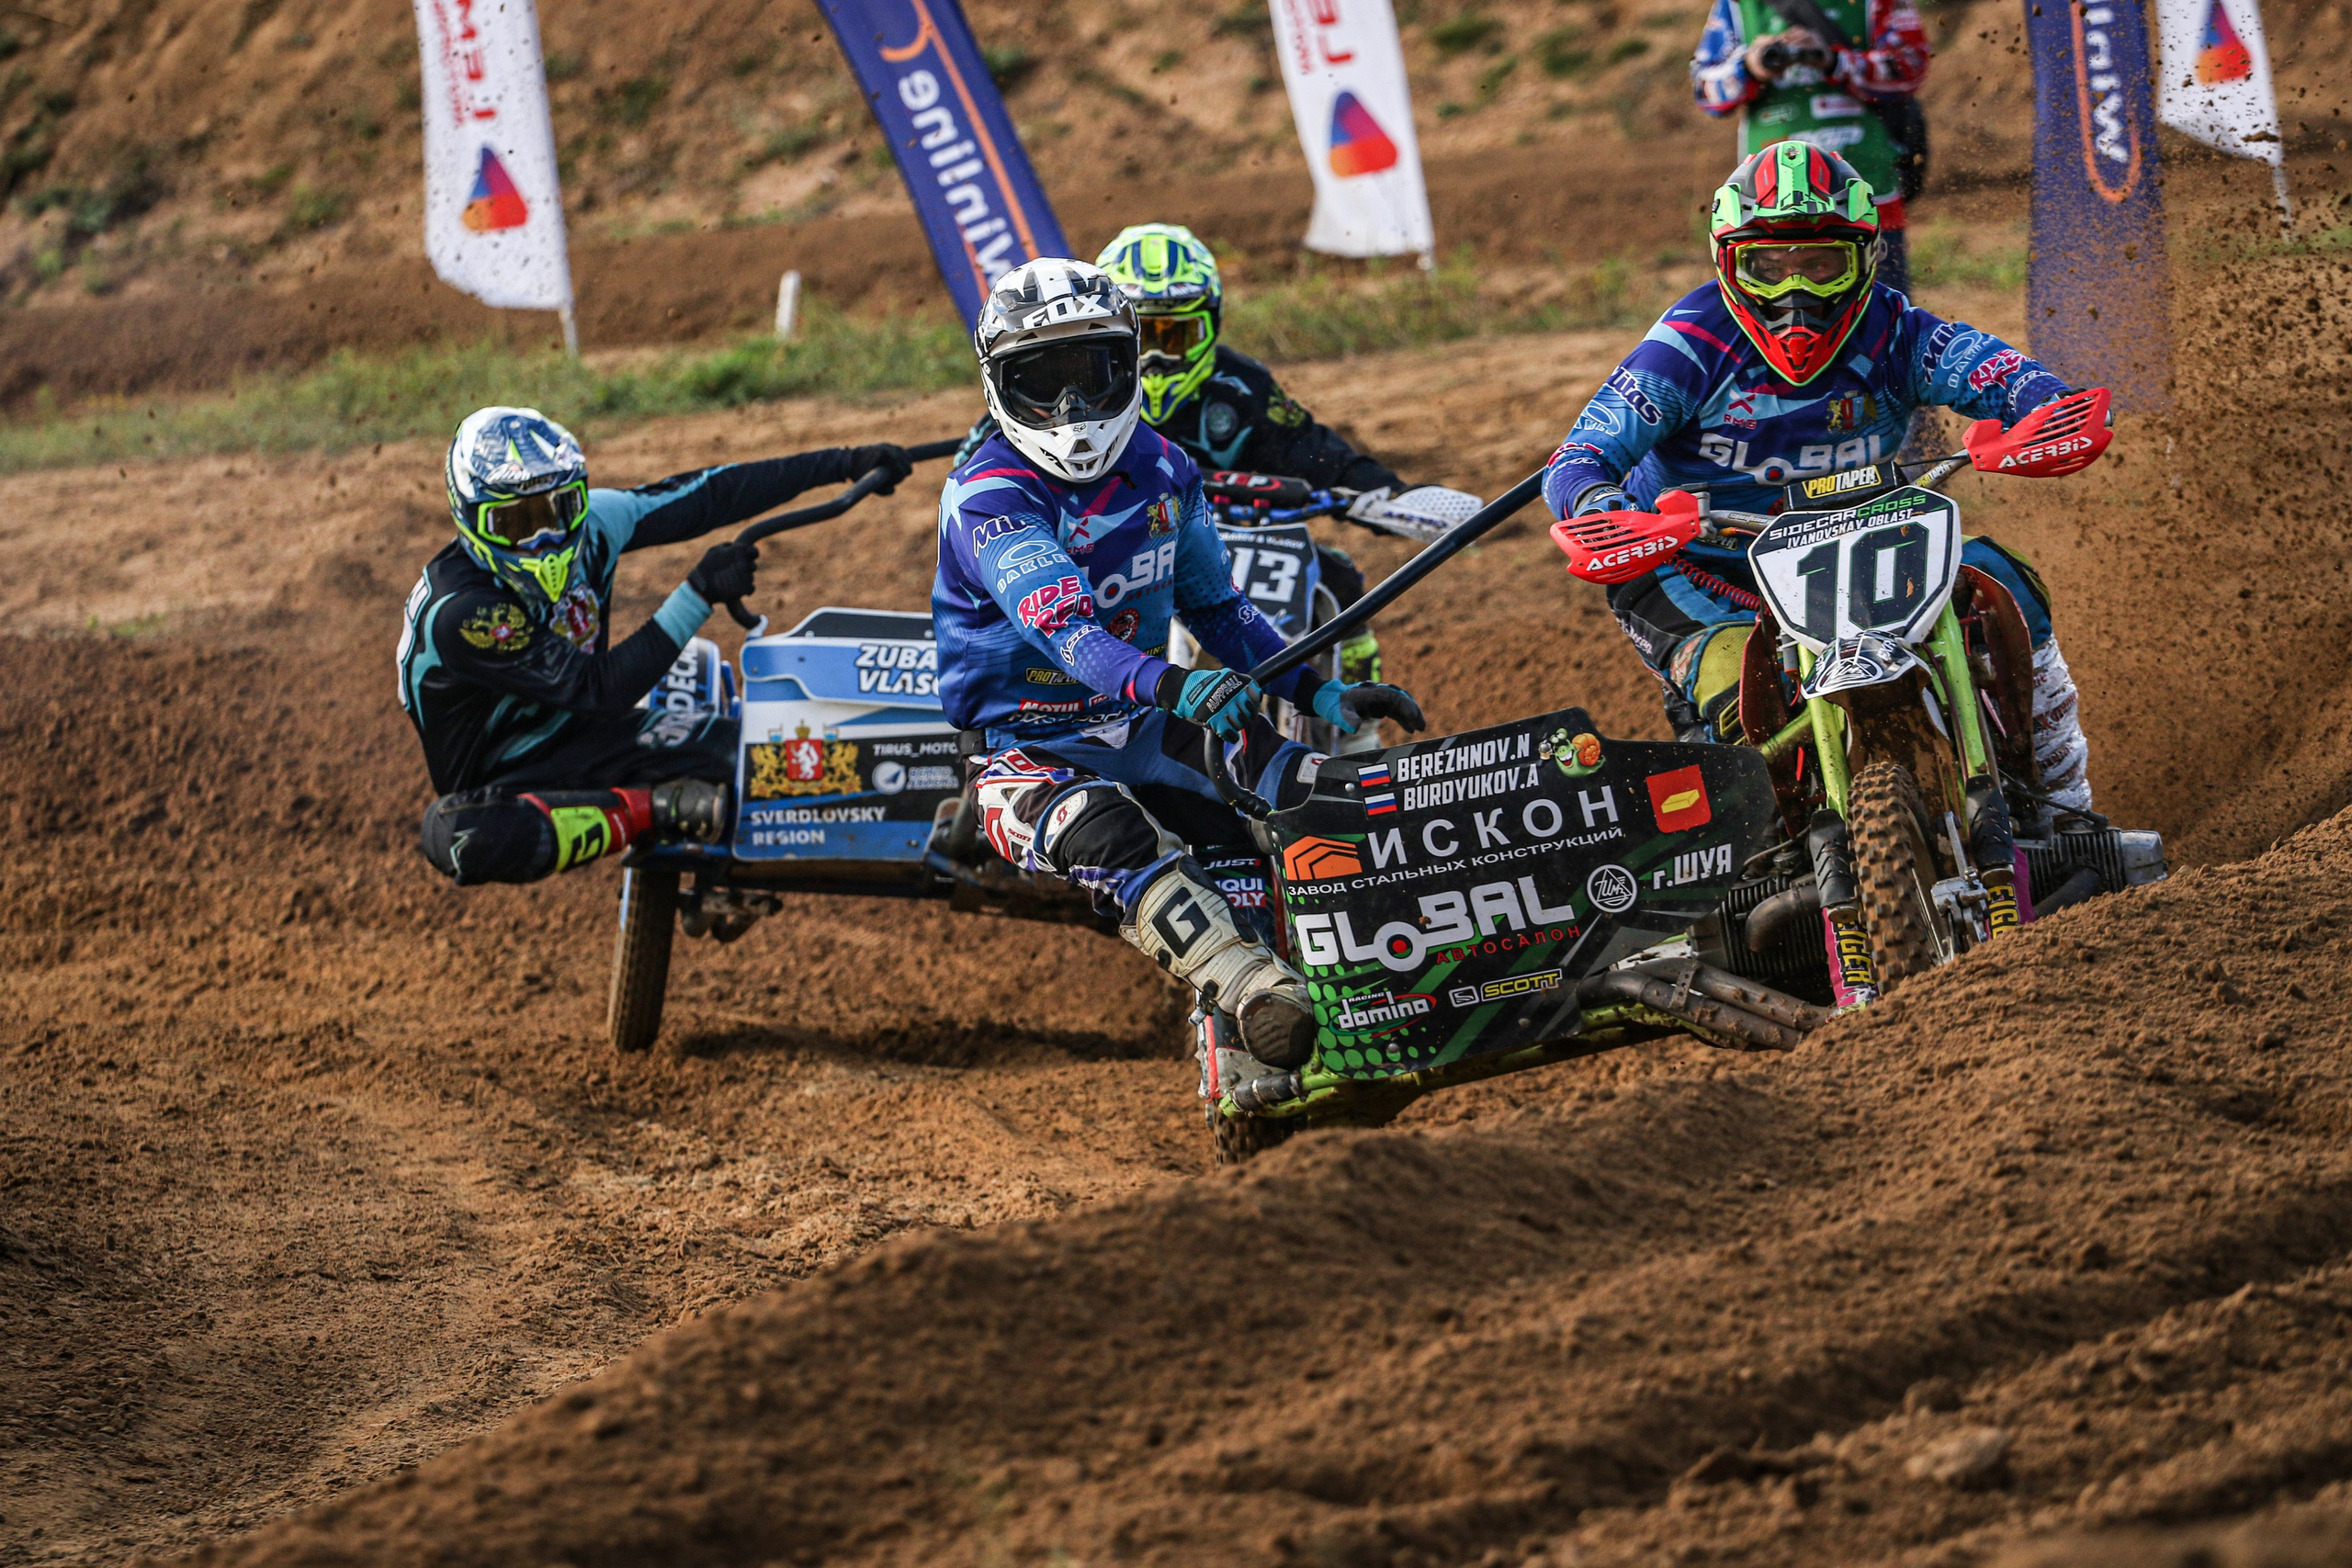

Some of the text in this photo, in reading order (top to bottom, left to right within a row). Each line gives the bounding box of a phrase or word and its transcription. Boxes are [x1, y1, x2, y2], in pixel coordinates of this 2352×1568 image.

[1023, 294, 1113, 328] FOX
[1724, 413, 1757, 430] RMG
[1997, 436, 2093, 469] ACERBIS
[1807, 466, 1877, 495] PROTAPER
[1769, 494, 1927, 540] SIDECARCROSS
[1786, 508, 1914, 549] IVANOVSKAY OBLAST
[1586, 536, 1679, 571] ACERBIS
[1231, 546, 1302, 604] 13
[1796, 522, 1929, 643] 10
[1017, 575, 1082, 628] RIDE
[1032, 594, 1094, 639] RED
[855, 645, 938, 670] ZUBA
[1022, 701, 1080, 713] MOTUL
[1396, 733, 1531, 783] BEREZHNOV.N
[1403, 763, 1539, 811] BURDYUKOV.A
[751, 807, 887, 826] SVERDLOVSKY
[1008, 828, 1032, 842] SCOTT
[1368, 785, 1619, 870] ИСКОН
[752, 829, 826, 846] REGION
[1288, 827, 1623, 897] ЗАВОД СТАЛЬНЫХ КОНСТРУКЦИЙ
[1653, 843, 1732, 890] г.ШУЯ
[1295, 875, 1576, 973] GLOBAL
[1435, 925, 1580, 965] АВТОСАЛОН
[1348, 992, 1385, 1003] RACING
[1484, 972, 1559, 999] SCOTT
[1338, 991, 1430, 1029] domino
